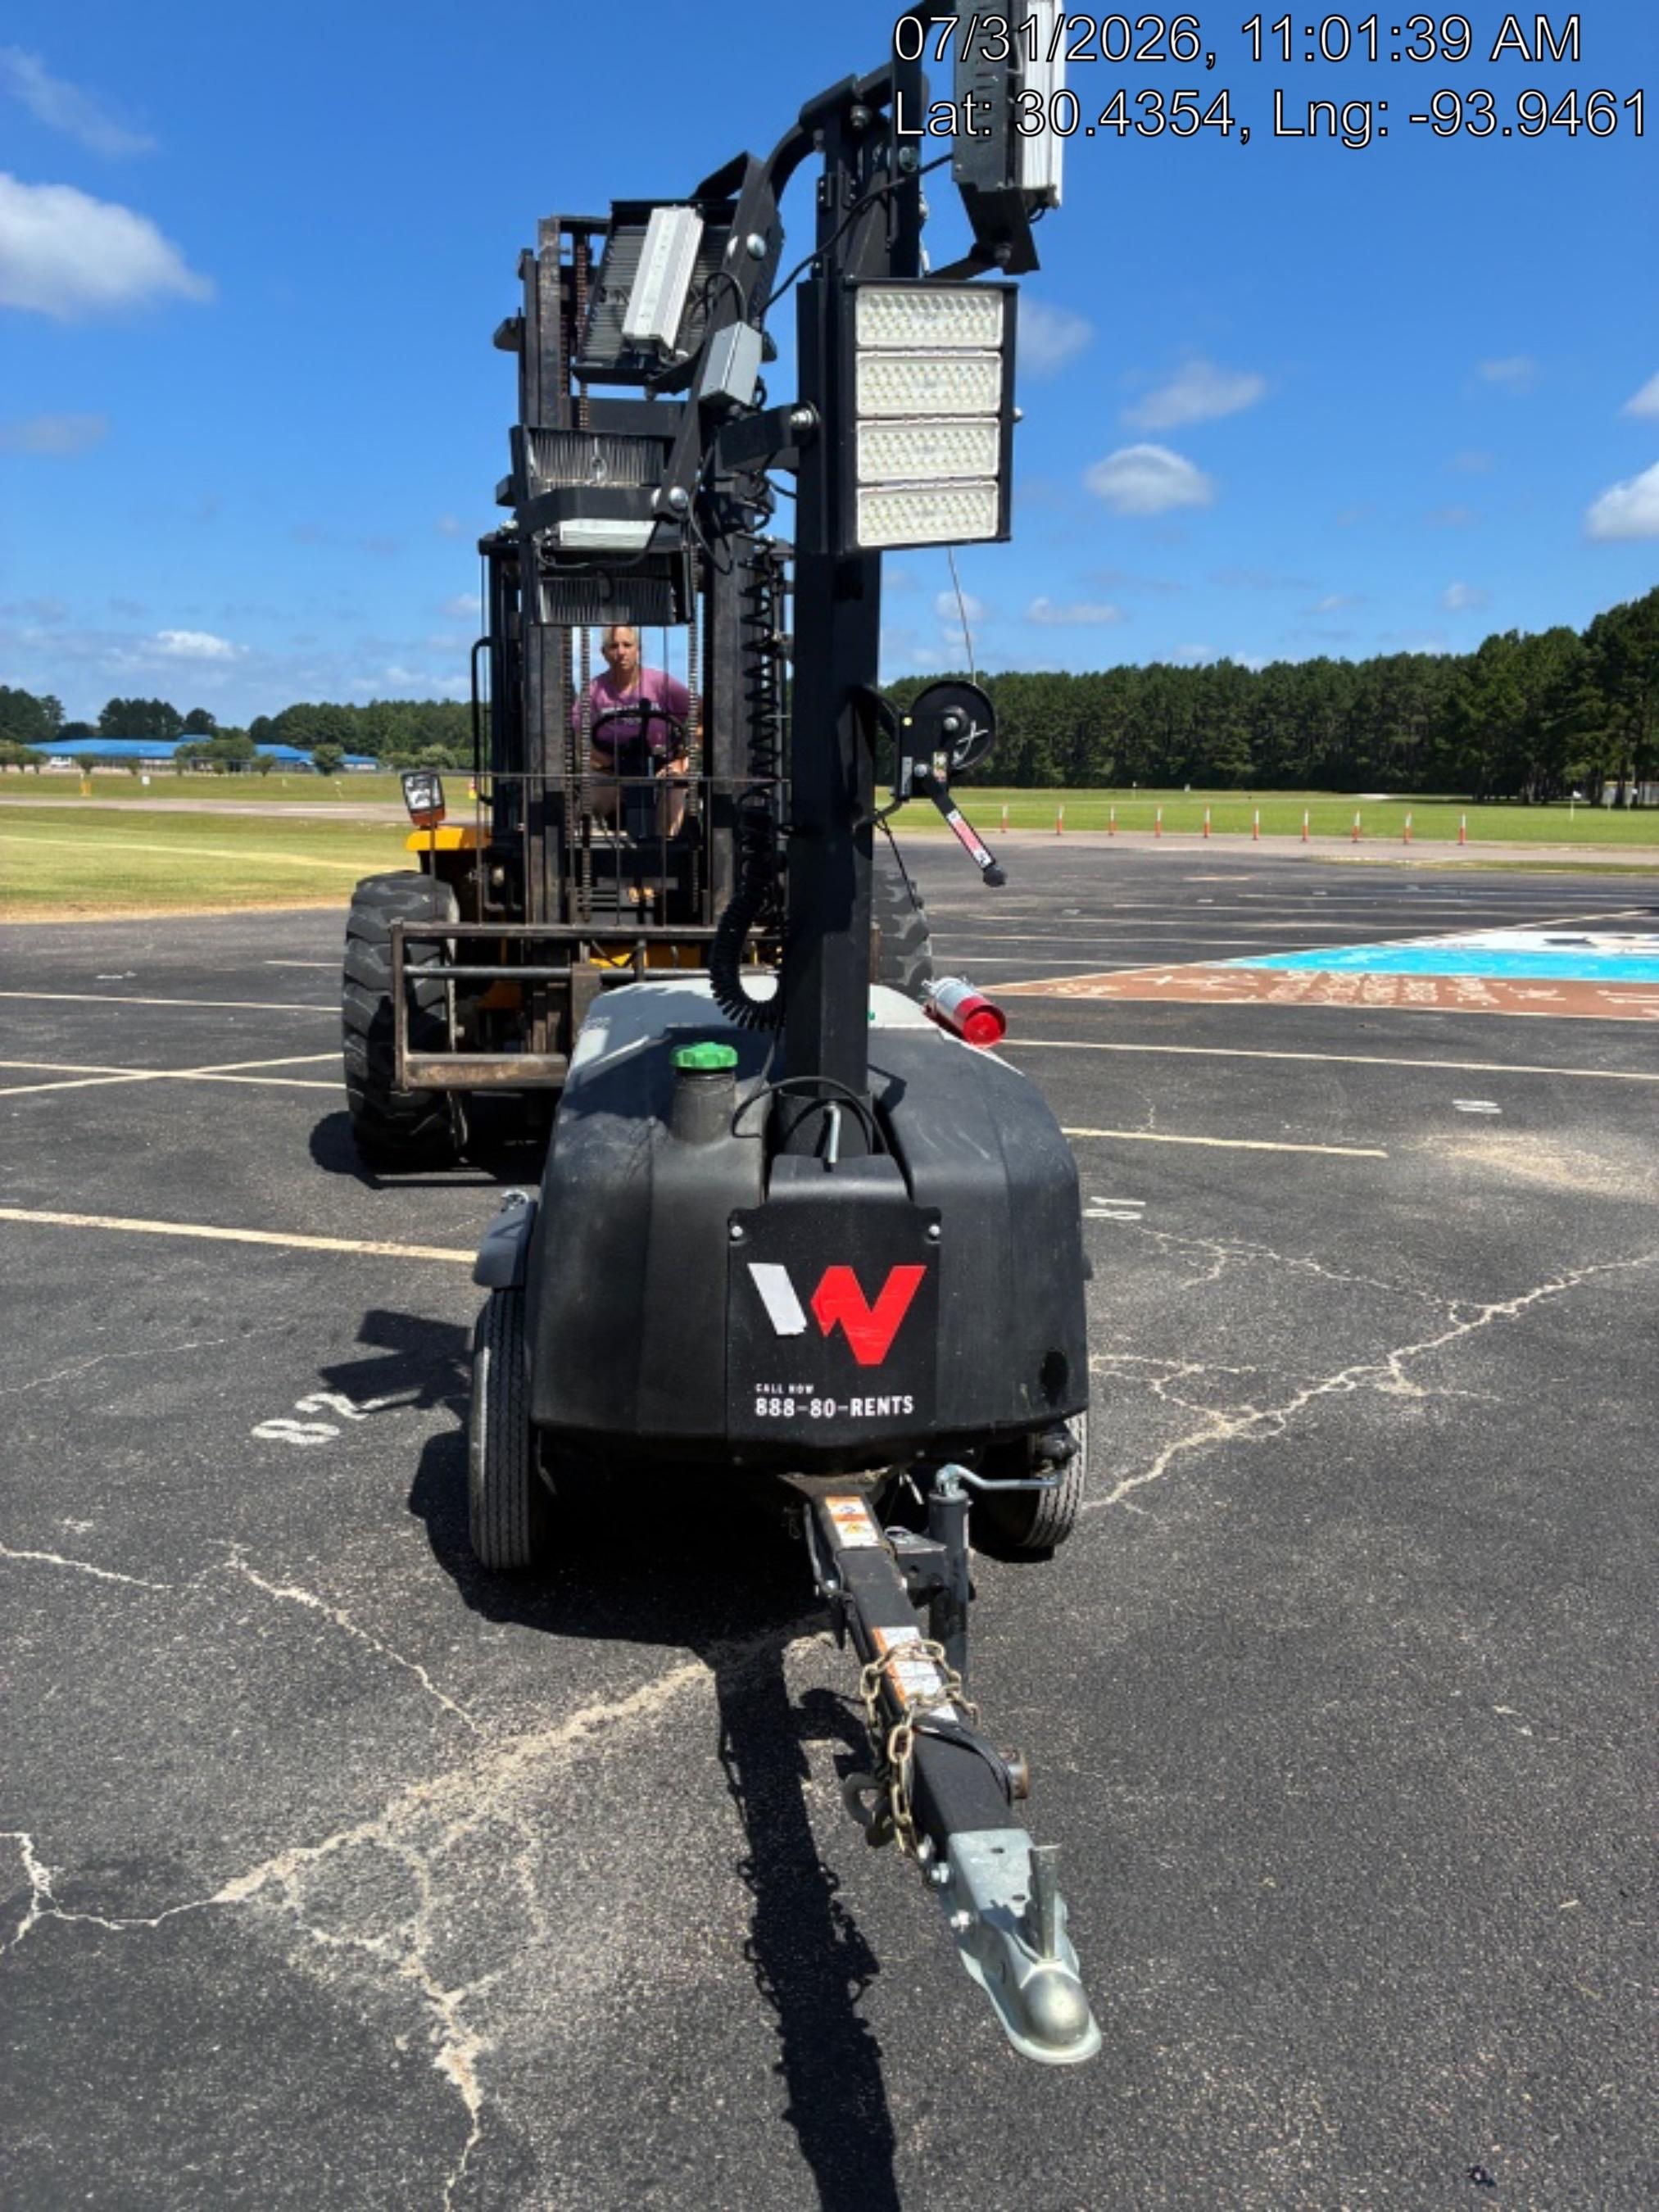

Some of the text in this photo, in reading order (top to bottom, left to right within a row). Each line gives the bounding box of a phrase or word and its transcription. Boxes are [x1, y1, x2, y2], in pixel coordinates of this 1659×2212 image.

[755, 1383, 814, 1394] CALL NOW
[755, 1394, 915, 1419] 888-80-RENTS
